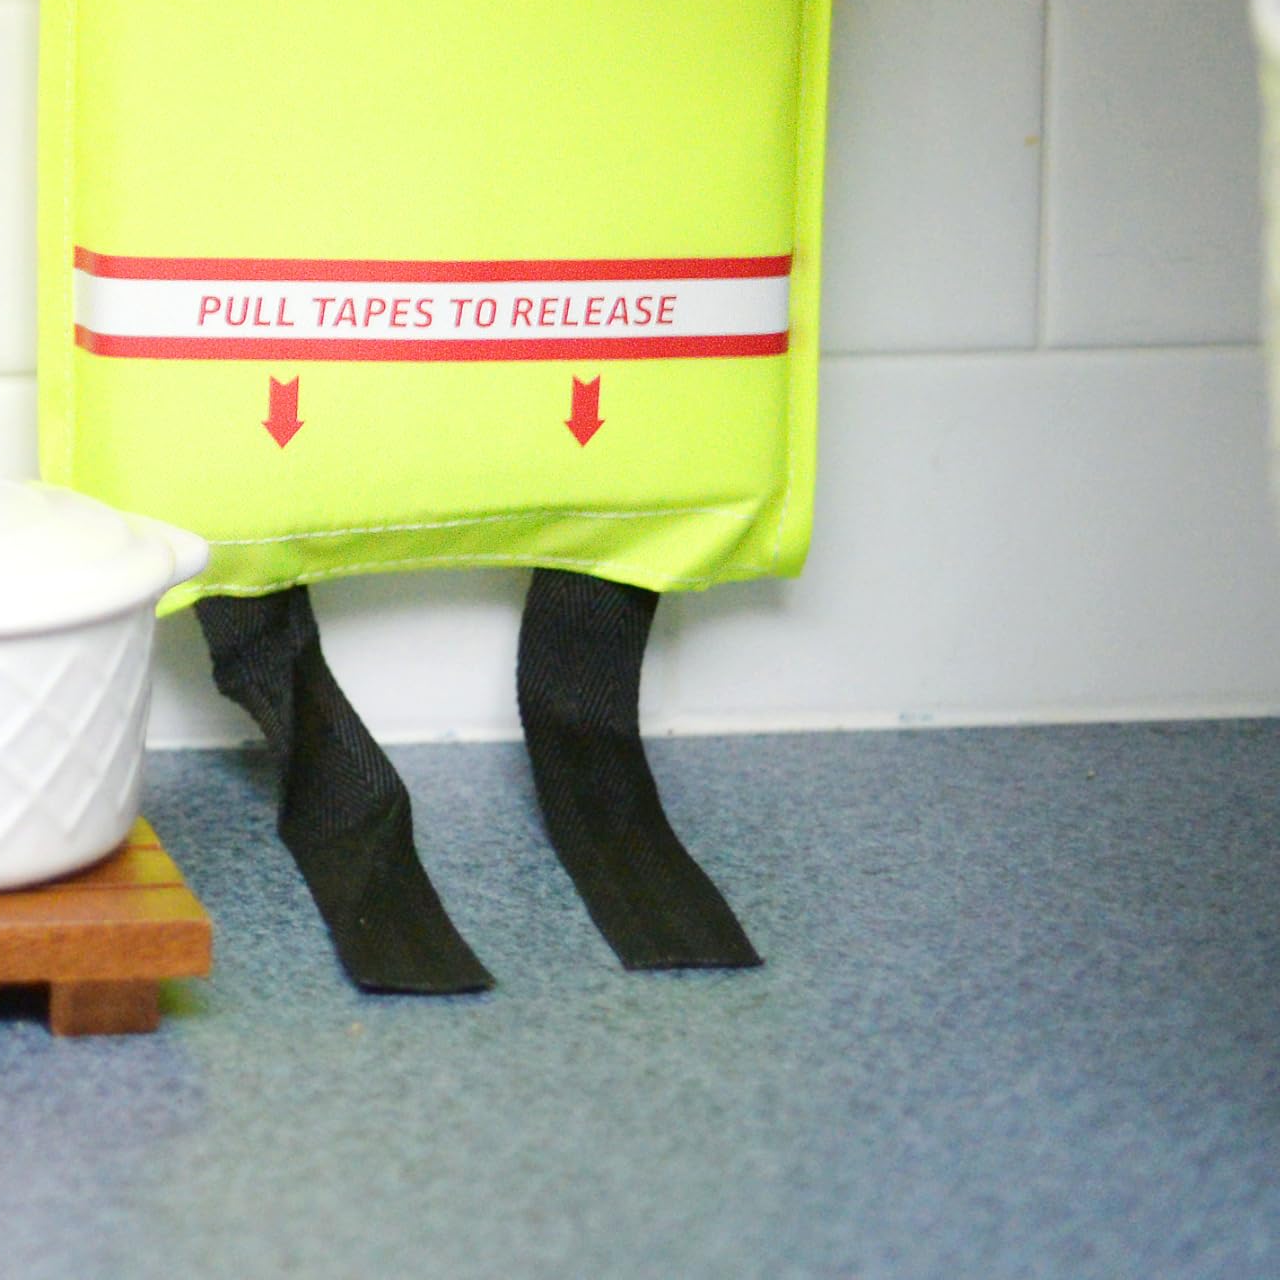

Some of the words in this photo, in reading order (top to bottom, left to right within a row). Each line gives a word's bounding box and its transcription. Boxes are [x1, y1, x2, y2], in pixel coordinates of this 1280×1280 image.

[197, 295, 295, 327] PULL
[311, 296, 434, 329] TAPES
[449, 297, 499, 328] TO
[509, 295, 678, 327] RELEASE
